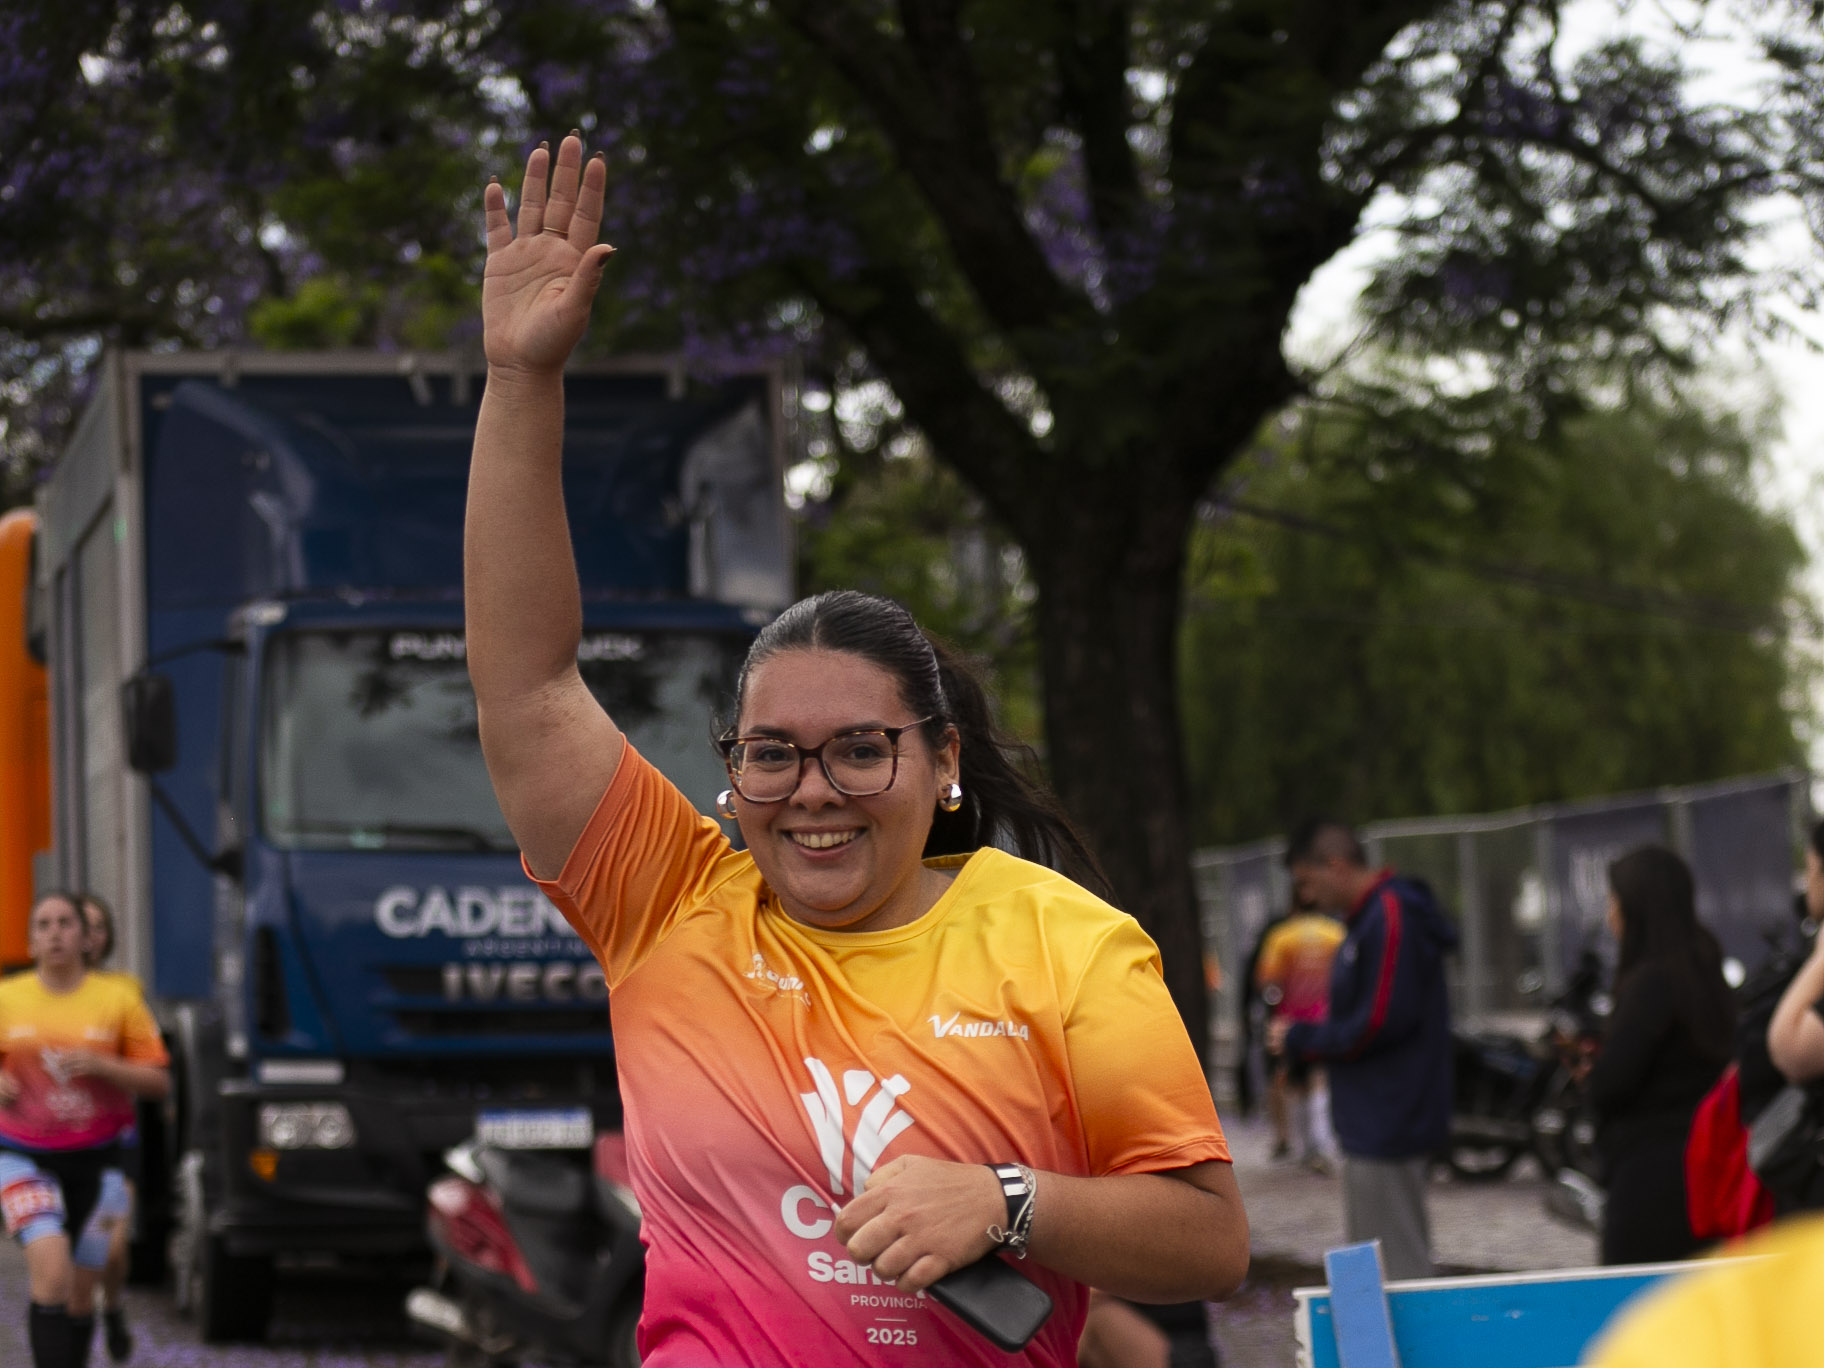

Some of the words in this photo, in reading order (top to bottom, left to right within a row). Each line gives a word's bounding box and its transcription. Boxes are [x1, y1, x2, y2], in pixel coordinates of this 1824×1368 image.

[376, 886, 577, 937] CADEN
[442, 961, 608, 1003] IVECO
[927, 1011, 1029, 1041] VANDALA
[807, 1251, 896, 1286] San
[850, 1294, 928, 1310] PROVINCIA
[866, 1328, 918, 1345] 2025
